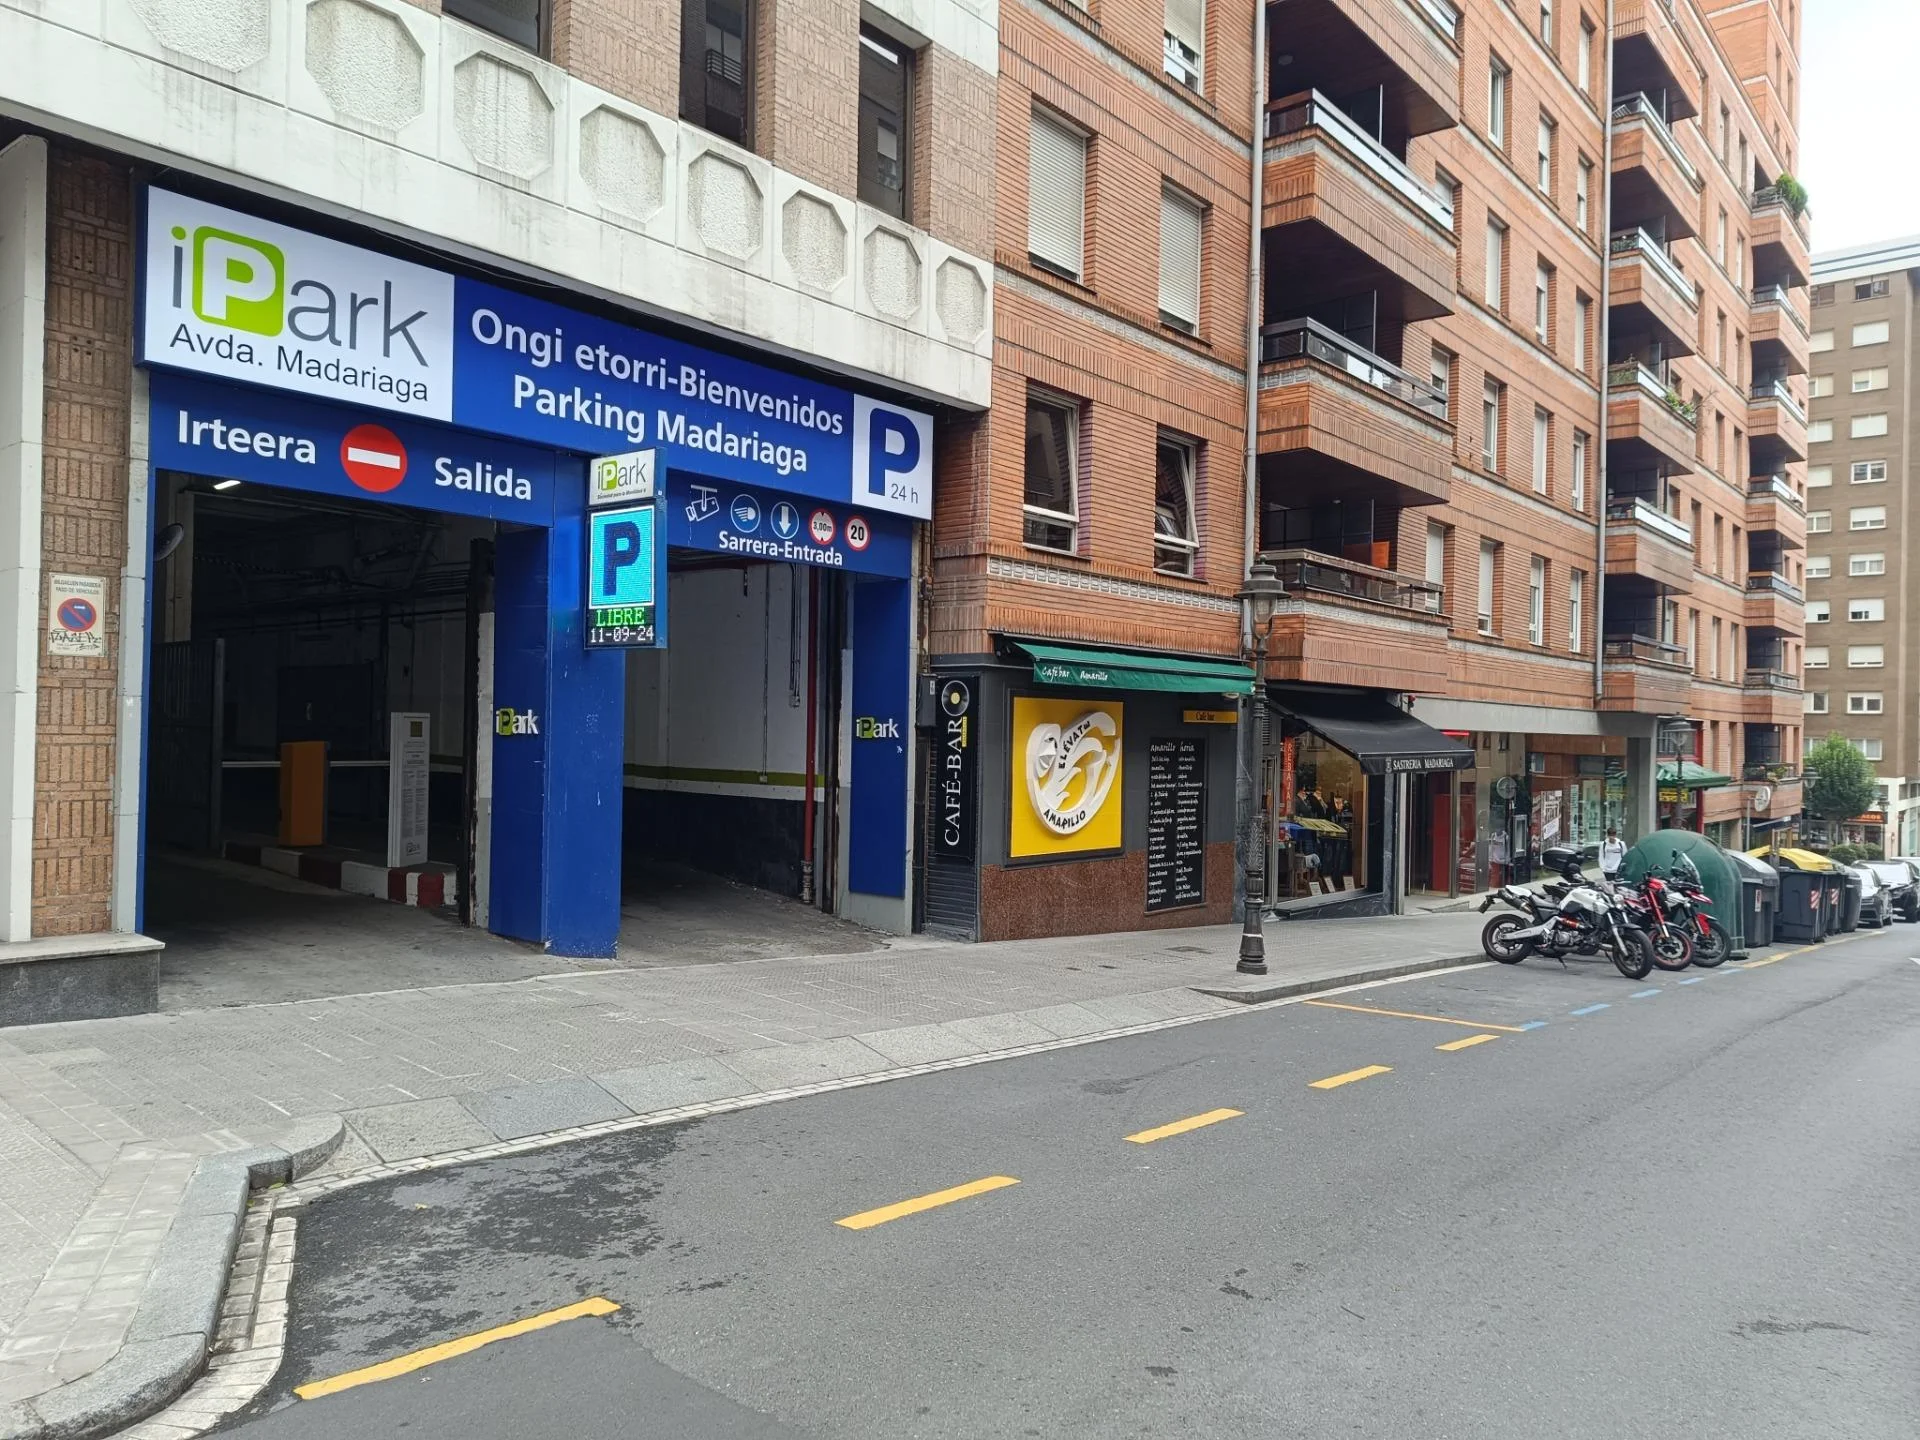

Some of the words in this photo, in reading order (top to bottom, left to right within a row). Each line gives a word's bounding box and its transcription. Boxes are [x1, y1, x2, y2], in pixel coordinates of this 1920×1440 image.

[171, 226, 429, 367] iPark
[169, 323, 263, 366] Avda.
[277, 345, 428, 402] Madariaga
[471, 308, 563, 369] Ongi
[574, 343, 844, 435] etorri-Bienvenidos
[177, 410, 317, 464] Irteera
[514, 374, 645, 442] Parking
[656, 409, 807, 476] Madariaga
[868, 407, 920, 496] P
[434, 457, 532, 501] Salida
[597, 458, 647, 491] iPark
[890, 483, 907, 501] 24
[911, 487, 919, 504] h
[813, 521, 833, 533] 3,00m
[850, 525, 865, 541] 20
[603, 520, 641, 596] P
[718, 530, 843, 566] Sarrera-Entrada
[590, 625, 654, 642] 11-09-24
[596, 607, 645, 627] LIBRE
[1080, 670, 1108, 681] Amarillo
[496, 708, 539, 735] iPark
[856, 717, 899, 738] iPark
[942, 717, 963, 846] CAFÉ-BAR
